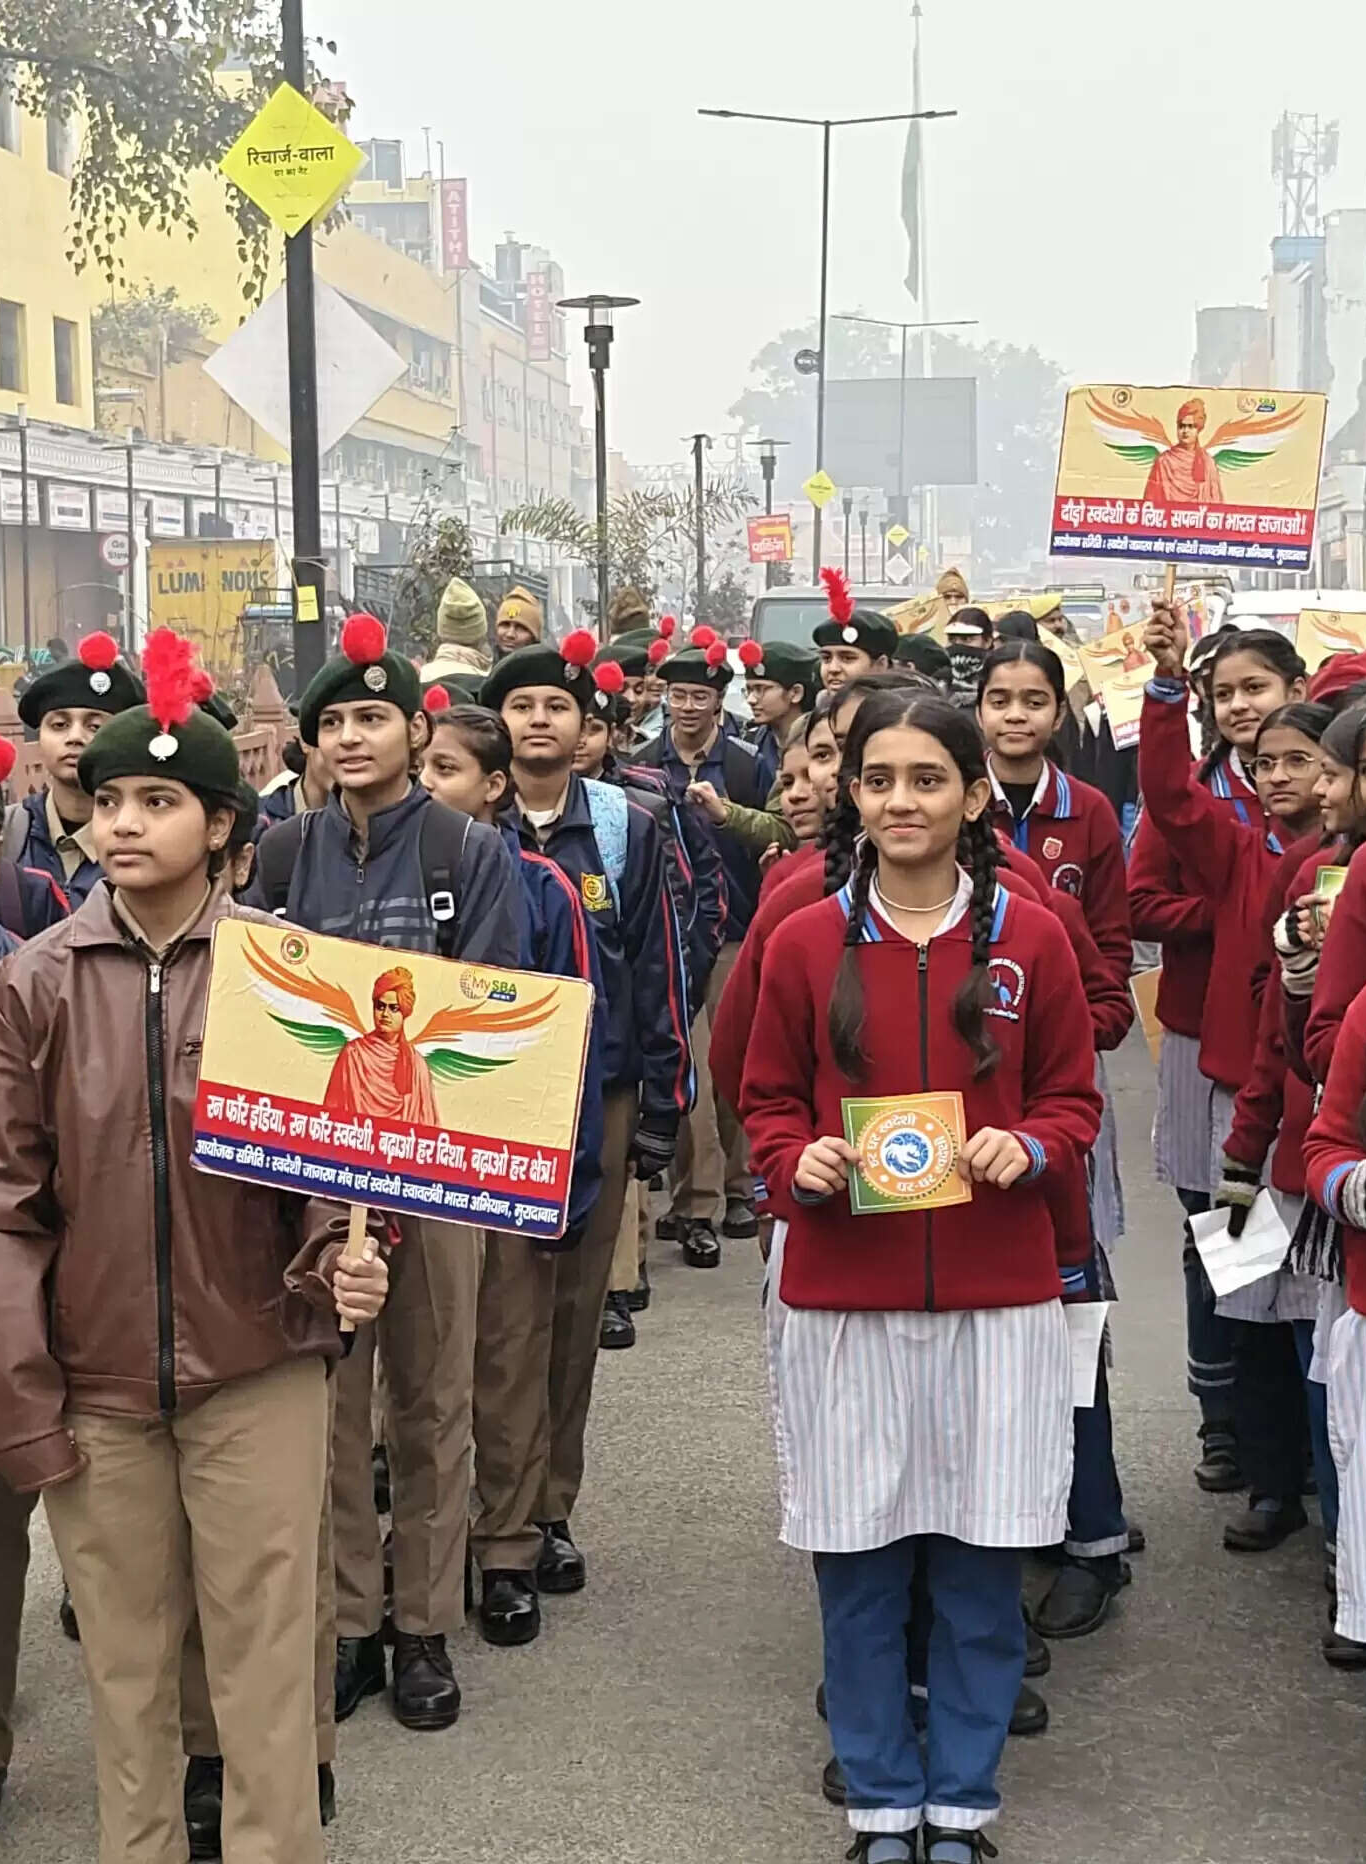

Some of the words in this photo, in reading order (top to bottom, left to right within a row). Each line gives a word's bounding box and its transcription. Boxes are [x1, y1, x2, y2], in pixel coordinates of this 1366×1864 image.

[247, 144, 334, 166] रिचार्ज-वाला
[447, 189, 462, 265] ATITHI
[1086, 499, 1124, 524] स्वदेशी
[1125, 501, 1140, 525] के
[1206, 511, 1224, 530] का
[1224, 513, 1257, 532] भारत
[206, 1094, 225, 1120] रन
[226, 1093, 249, 1125] फॉर
[289, 1112, 308, 1138] रन
[308, 1111, 332, 1144] फॉर
[379, 1127, 415, 1164] बढ़ाओ
[415, 1138, 435, 1164] हर
[471, 1144, 507, 1181] बढ़ाओ
[509, 1155, 529, 1181] हर
[879, 1112, 917, 1134] स्वदेशी
[195, 1138, 236, 1160] आयोजक
[236, 1144, 264, 1168] समिति
[271, 1153, 302, 1176] स्वदेशी
[302, 1162, 336, 1183] जागरण
[336, 1166, 353, 1187] मंच
[353, 1169, 371, 1190] एवं
[370, 1173, 401, 1197] स्वदेशी
[444, 1190, 469, 1208] भारत
[514, 1202, 560, 1226] मुरादाबाद
